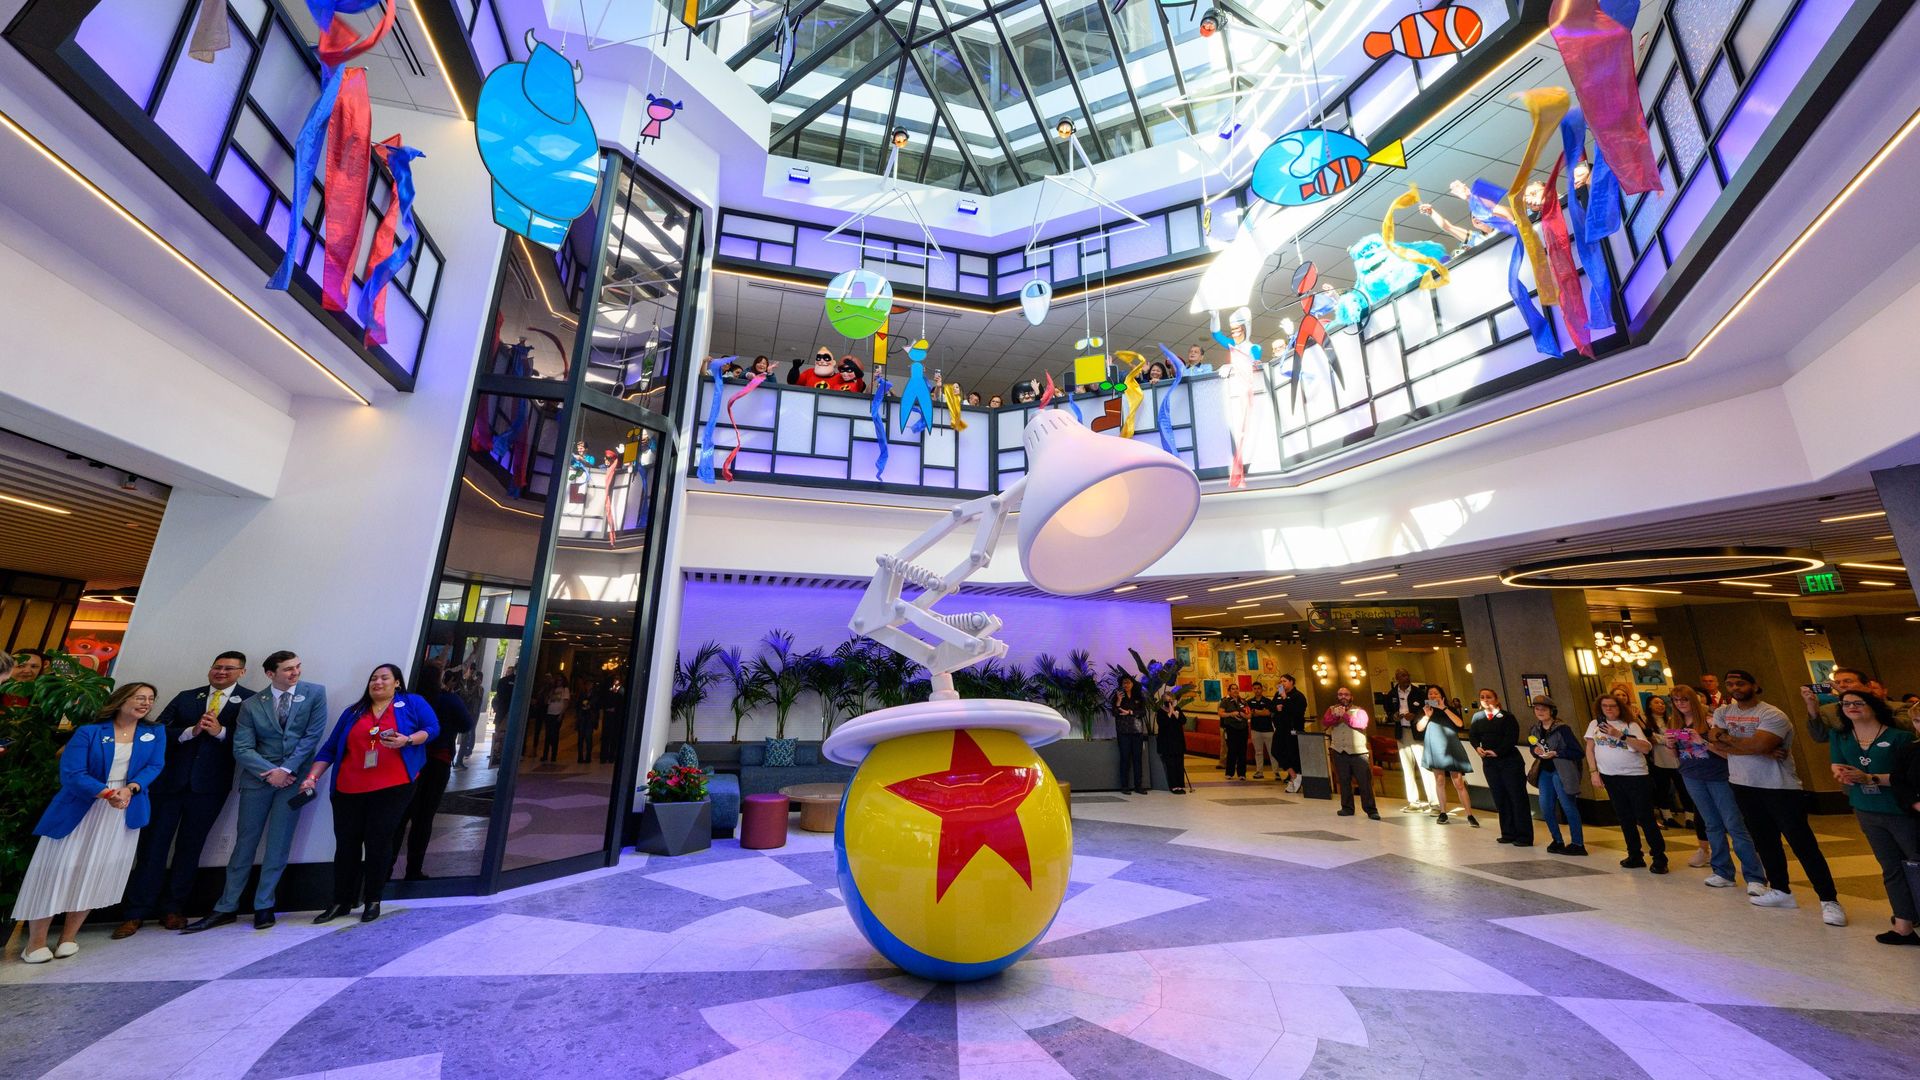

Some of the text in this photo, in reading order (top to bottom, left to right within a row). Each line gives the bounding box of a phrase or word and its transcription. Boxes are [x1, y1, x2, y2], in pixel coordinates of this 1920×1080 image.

[1805, 573, 1835, 592] EXIT
[1332, 609, 1416, 620] The Sketch Pad
